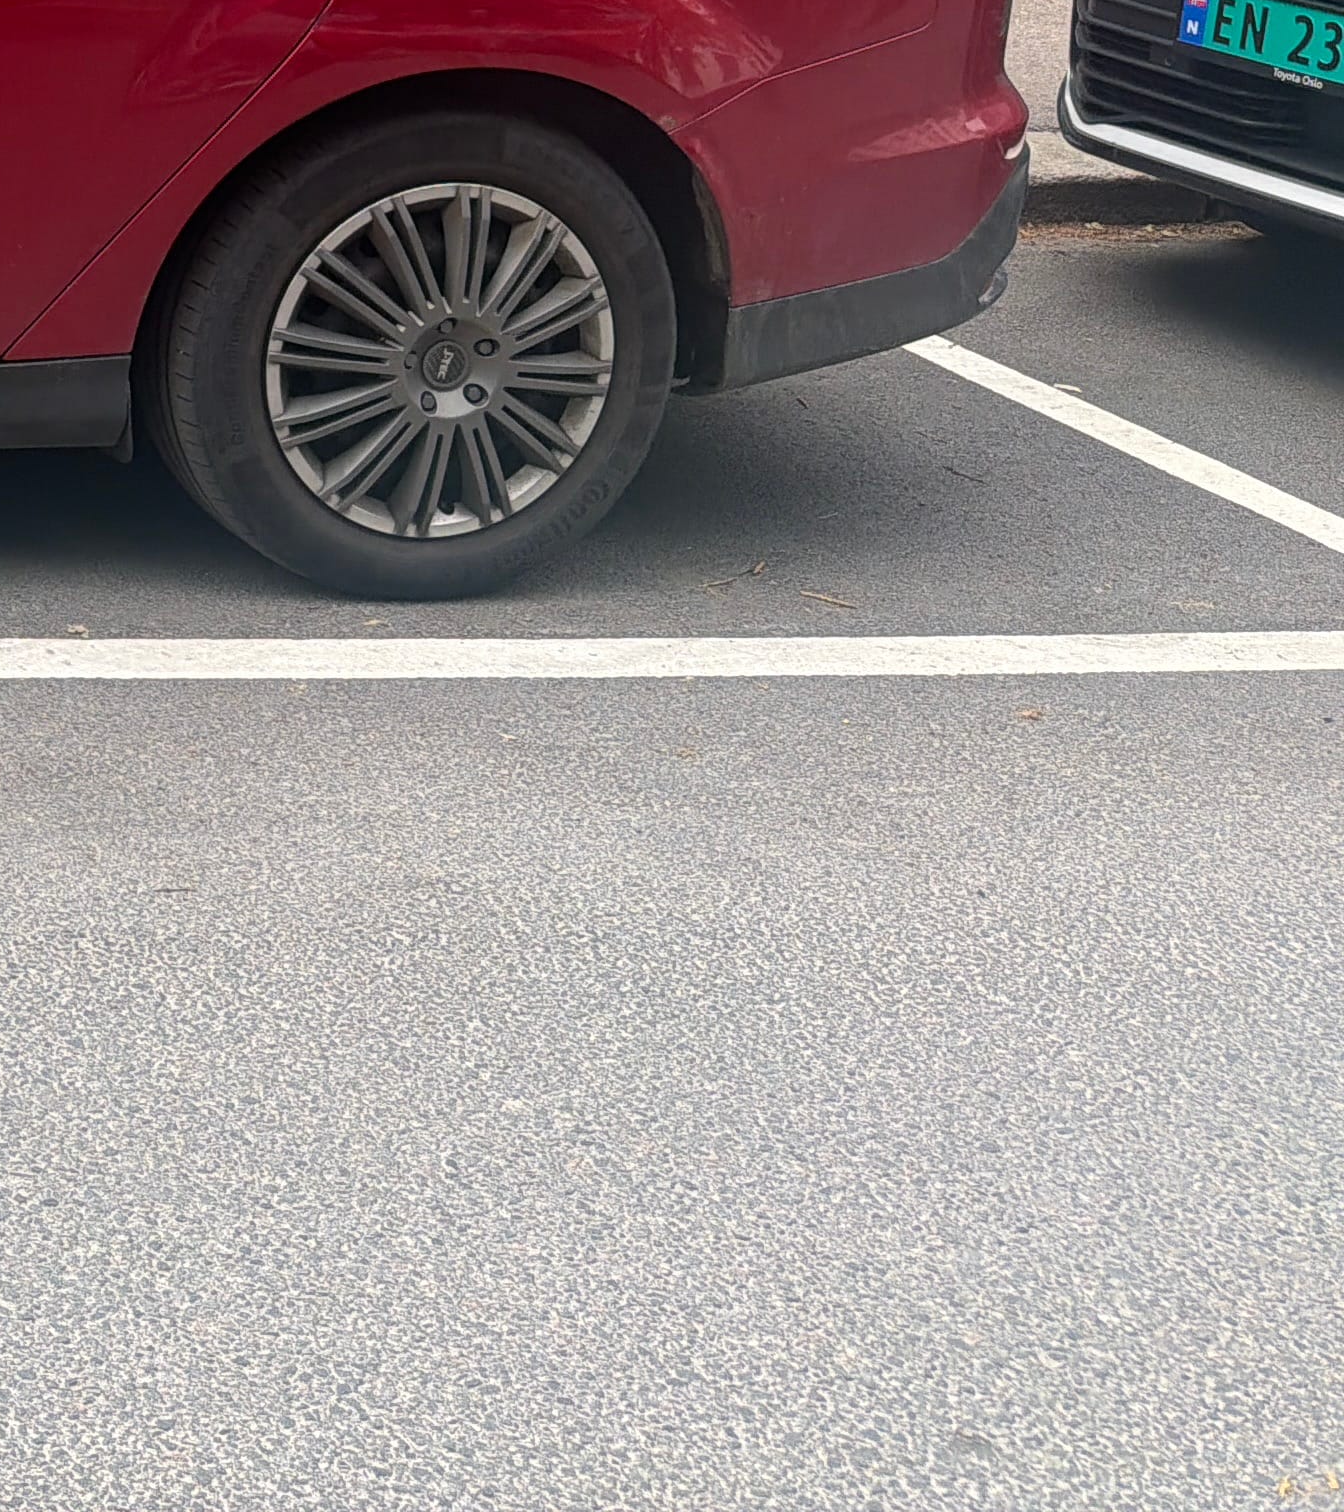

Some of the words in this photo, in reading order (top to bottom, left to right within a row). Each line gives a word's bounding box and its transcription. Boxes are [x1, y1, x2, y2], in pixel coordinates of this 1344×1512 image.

[1186, 19, 1200, 36] N
[1288, 15, 1343, 72] 23
[1273, 67, 1301, 83] Toyota
[1302, 75, 1323, 90] Oslo
